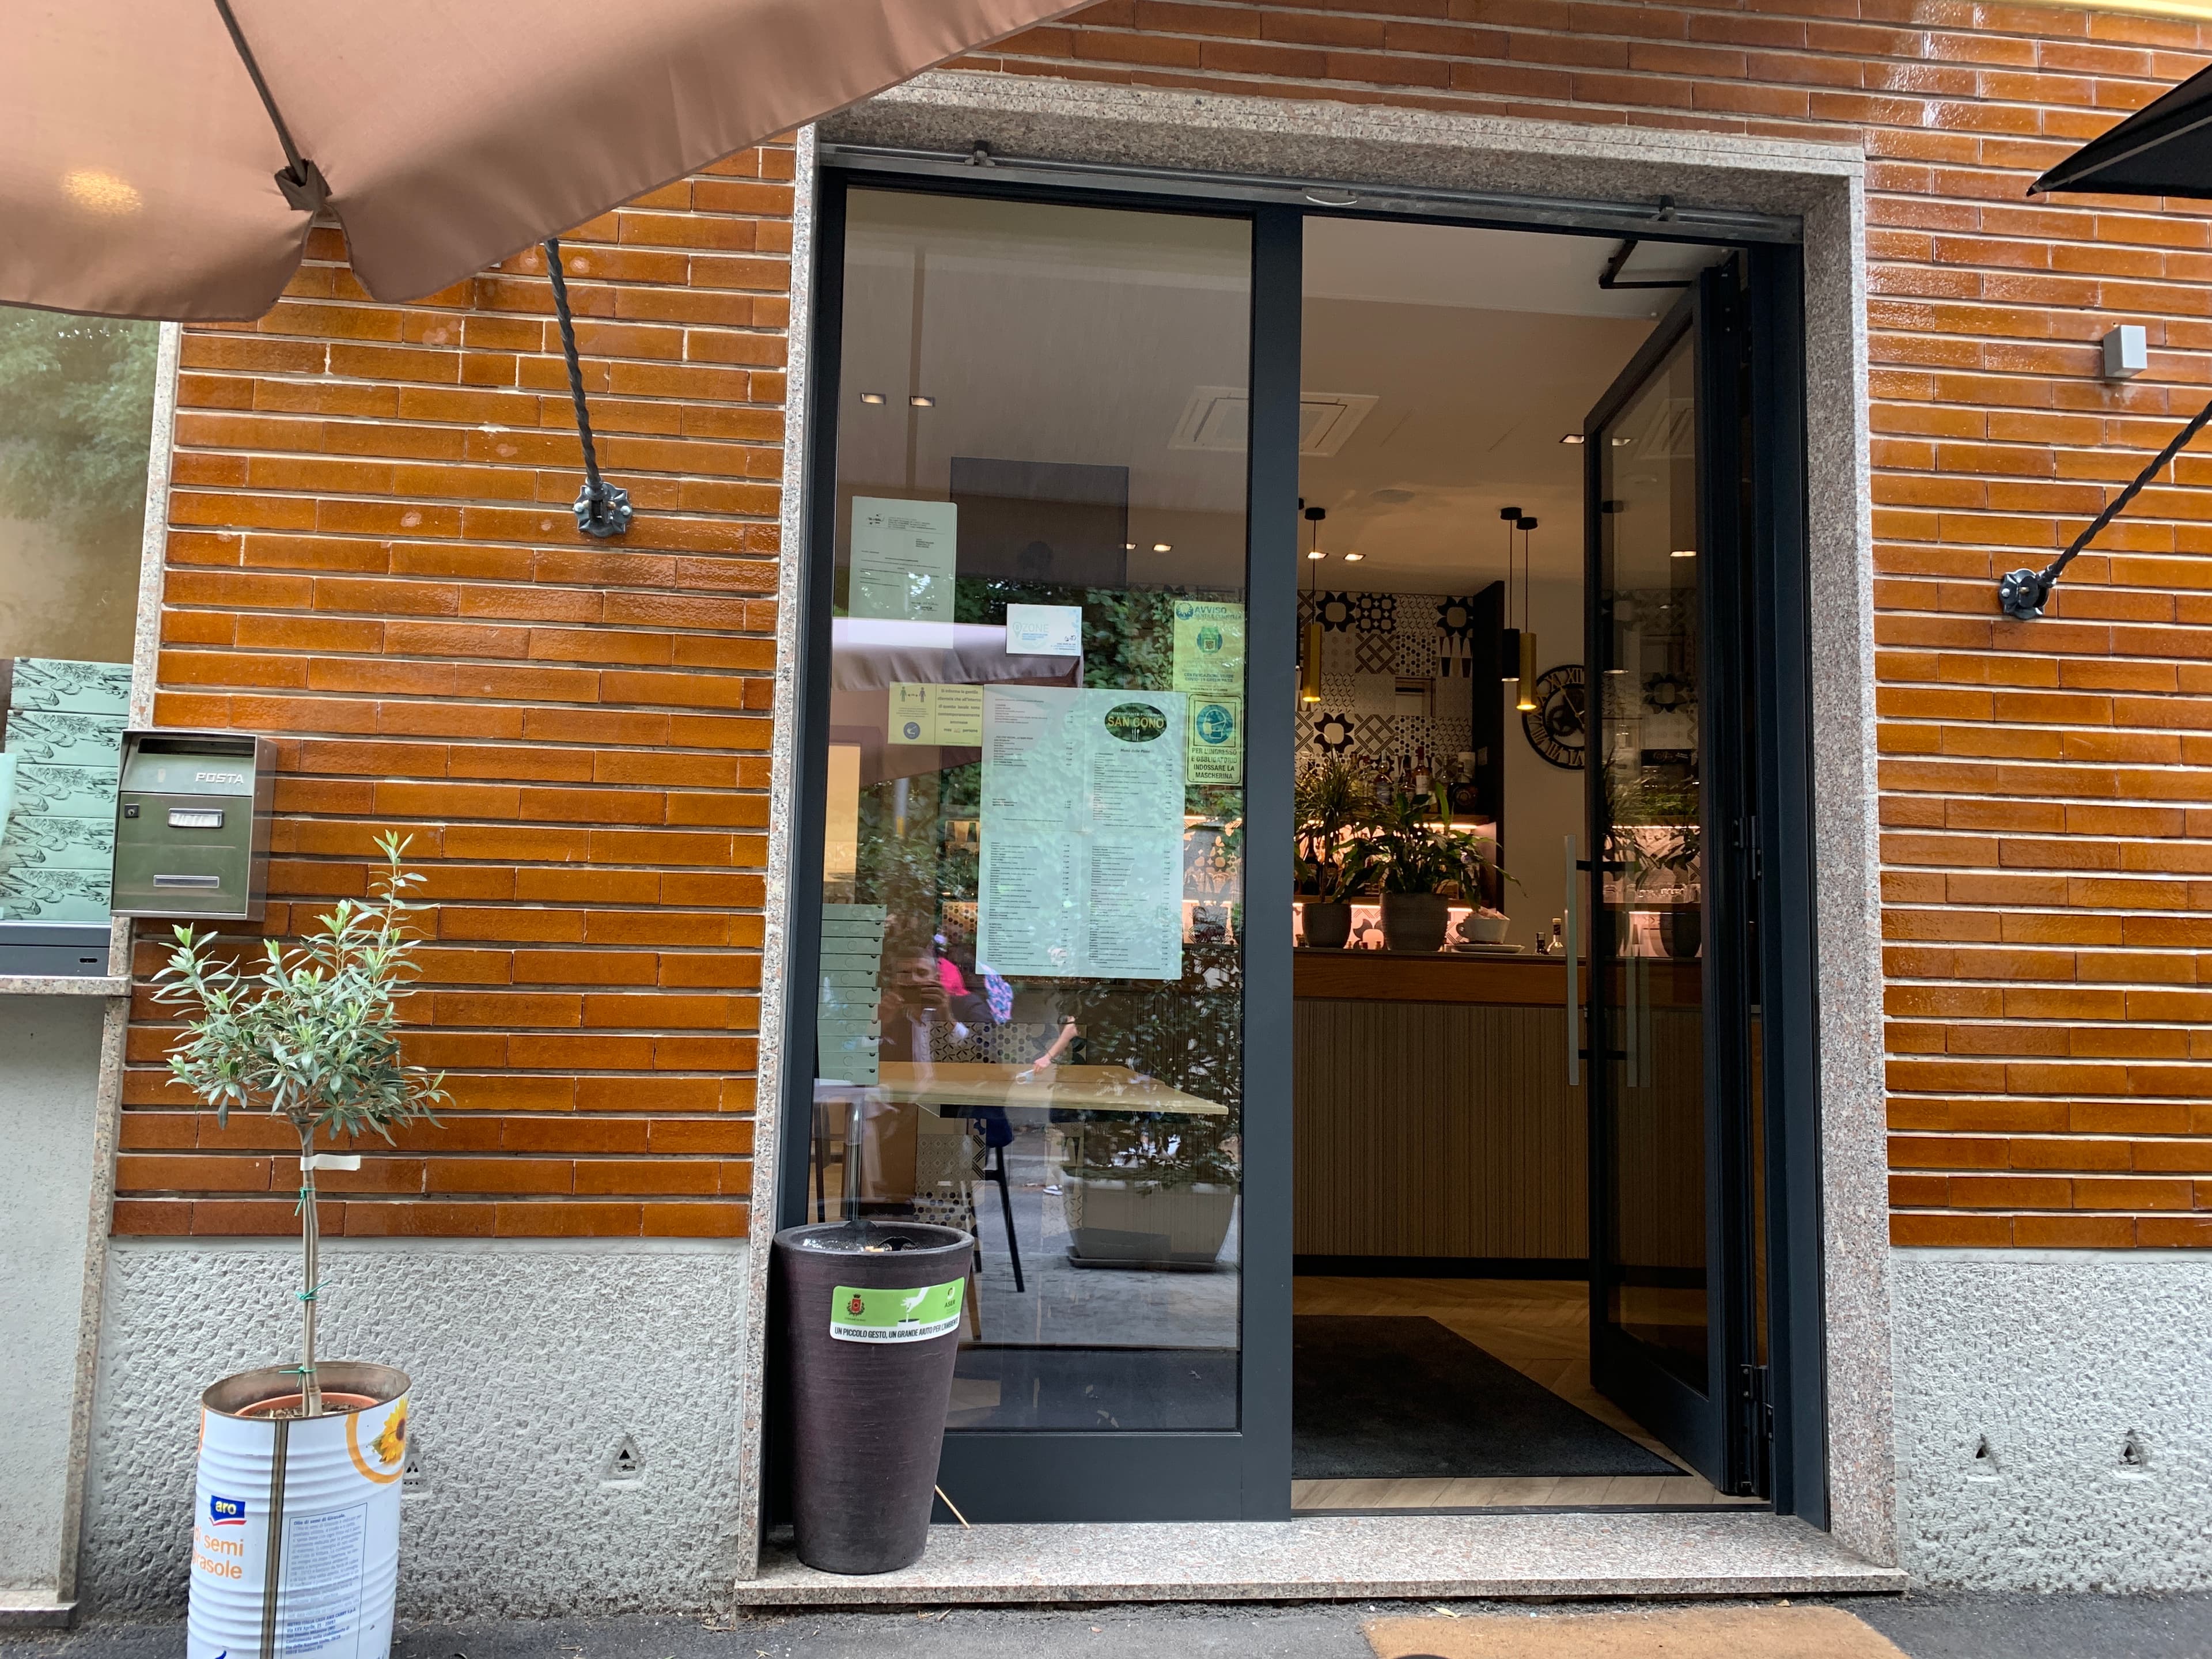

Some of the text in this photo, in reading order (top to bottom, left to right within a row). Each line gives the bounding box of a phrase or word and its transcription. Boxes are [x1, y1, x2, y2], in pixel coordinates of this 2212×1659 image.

[1195, 606, 1227, 614] AVVISO
[1108, 716, 1164, 729] SAN CONO
[195, 772, 244, 784] POSTA
[945, 1300, 956, 1308] ASER
[835, 1327, 842, 1335] UN
[843, 1328, 868, 1337] PICCOLO
[868, 1330, 888, 1339] GESTO,
[898, 1329, 919, 1338] GRANDE
[919, 1327, 932, 1336] AIUTO
[933, 1325, 941, 1333] PER
[941, 1317, 959, 1331] L'AMBIENTE
[215, 1501, 236, 1515] aro
[204, 1535, 244, 1557] semi
